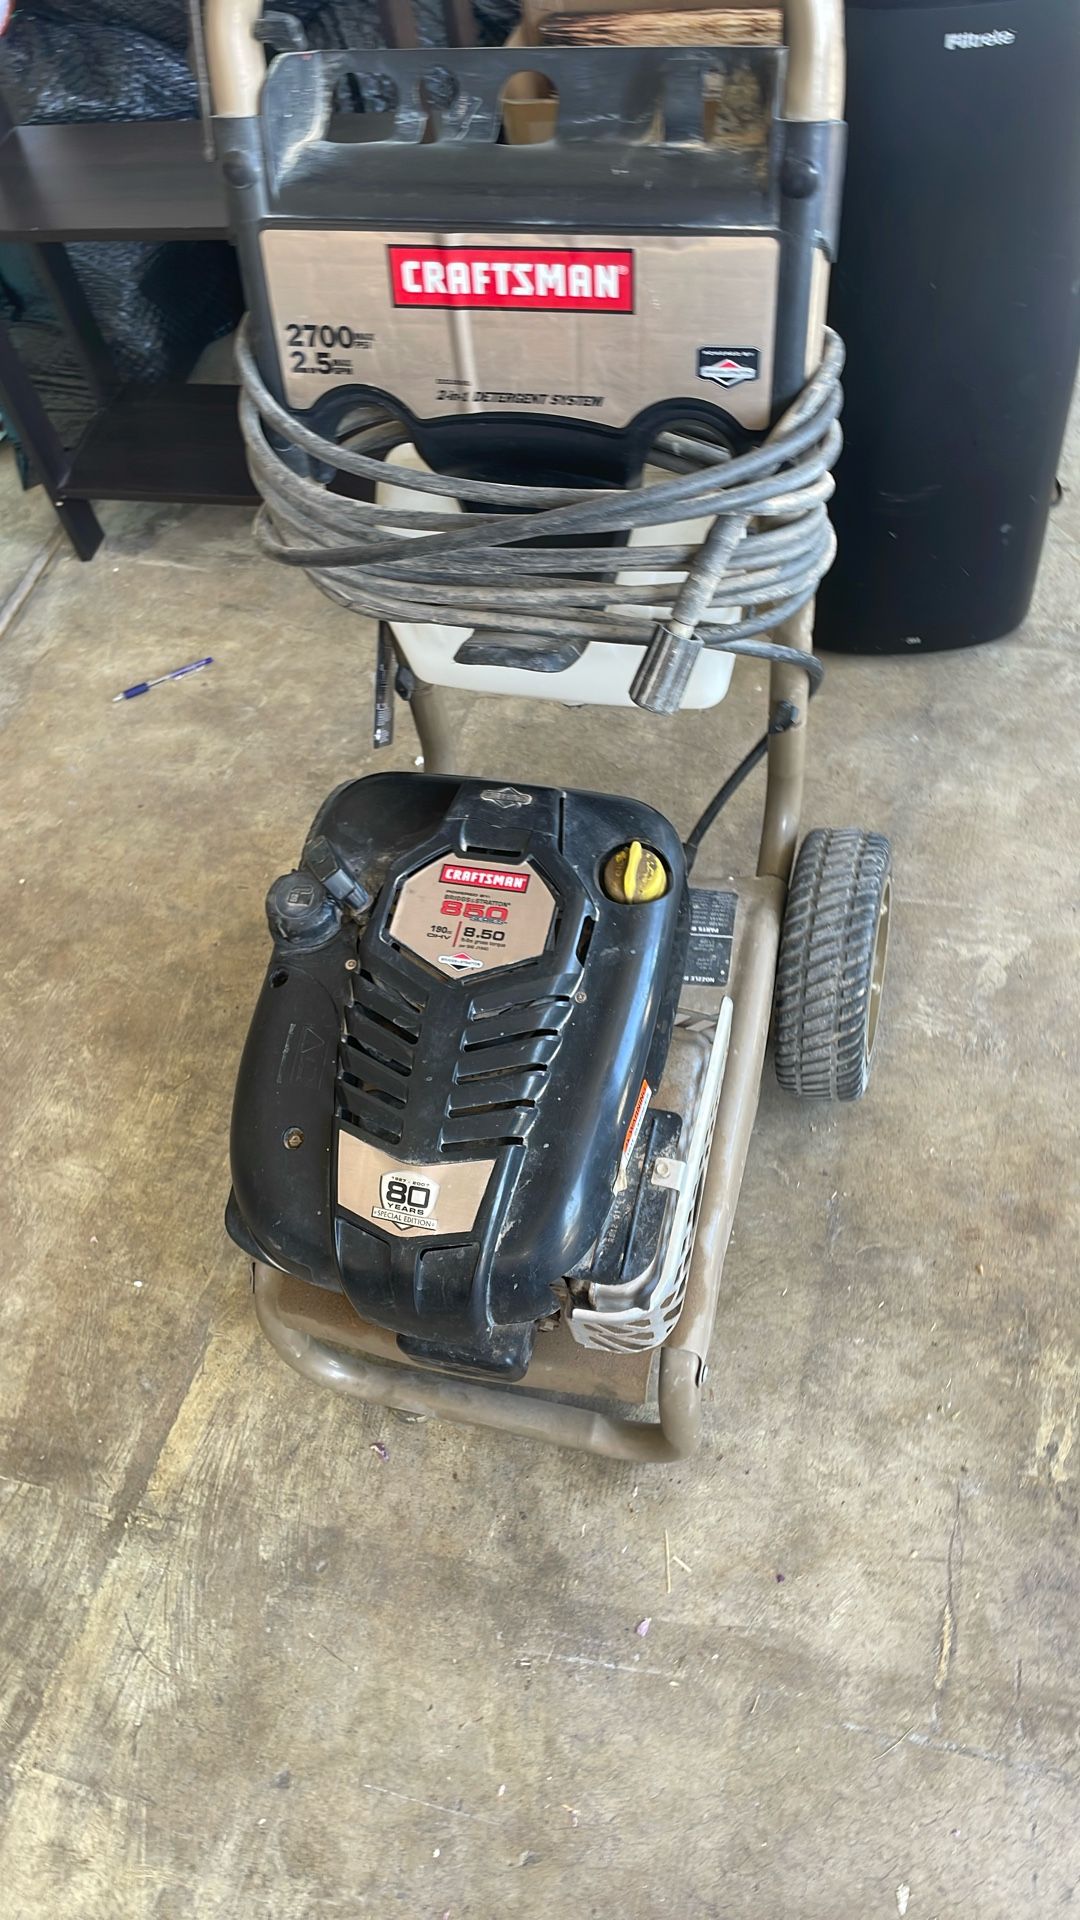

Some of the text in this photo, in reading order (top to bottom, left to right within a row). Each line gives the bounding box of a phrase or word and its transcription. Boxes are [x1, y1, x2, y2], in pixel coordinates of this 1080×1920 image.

[401, 261, 620, 298] CRAFTSMAN
[286, 324, 352, 348] 2700
[290, 351, 331, 374] 2.5
[472, 391, 550, 405] DETERGENT
[550, 394, 606, 407] SYSTEM
[445, 869, 525, 888] CRAFTSMAN
[440, 900, 508, 922] 850
[463, 926, 506, 941] 8.50
[386, 1181, 430, 1208] 80
[377, 1210, 431, 1227] SPECIAL EDITION
[387, 1202, 424, 1215] YEARS
